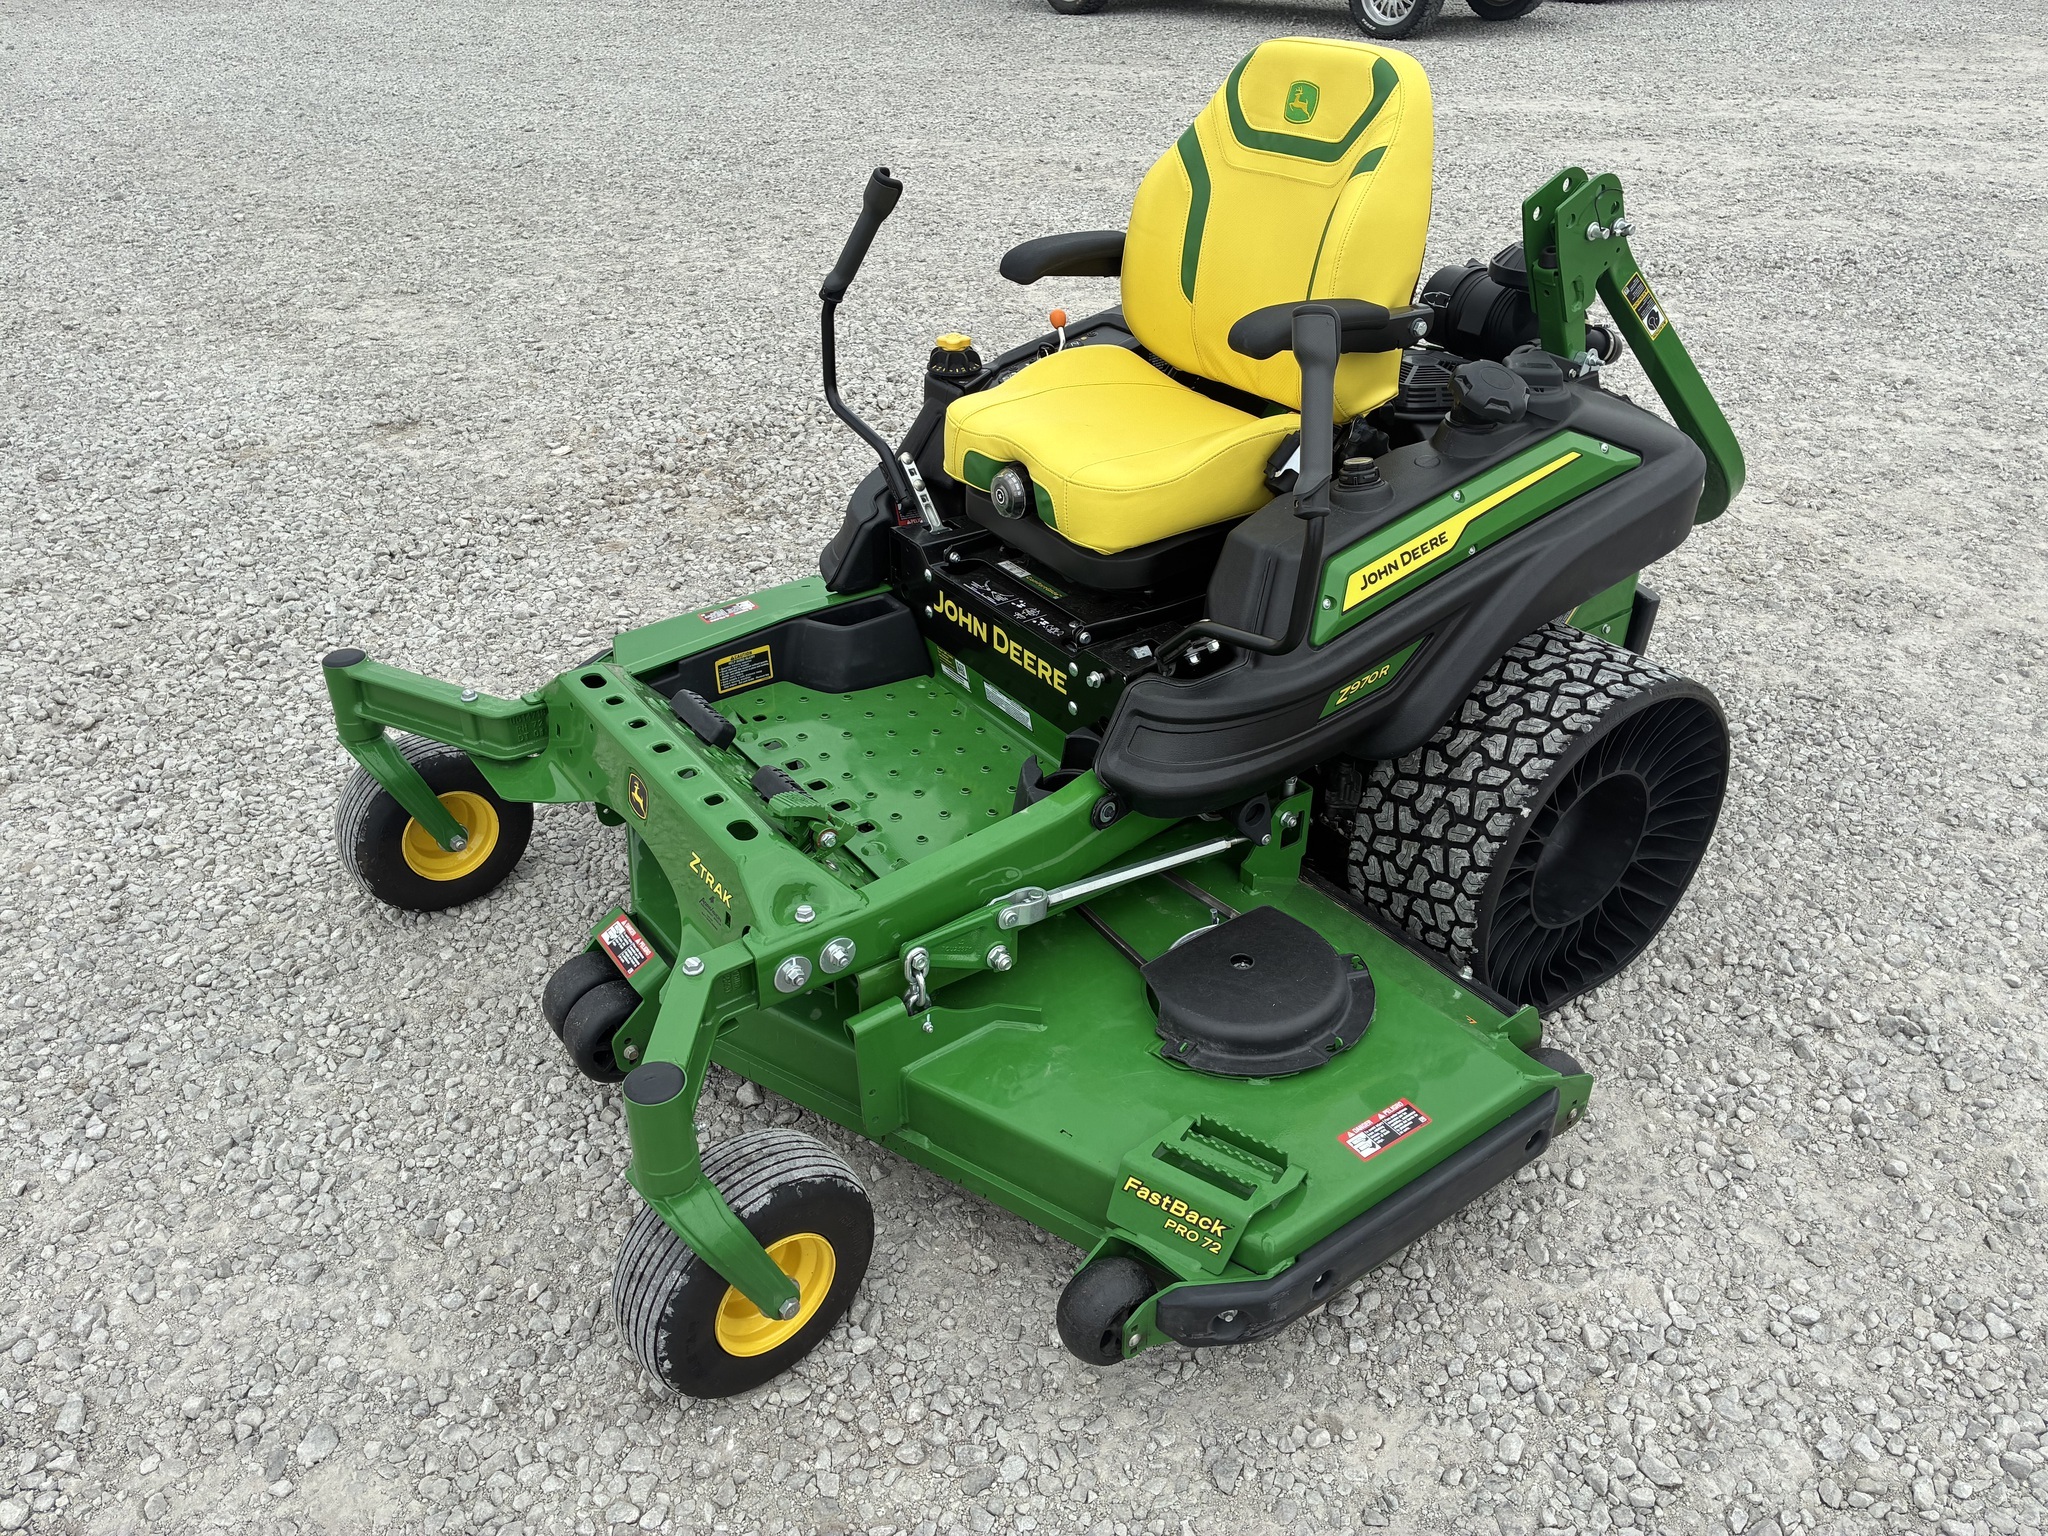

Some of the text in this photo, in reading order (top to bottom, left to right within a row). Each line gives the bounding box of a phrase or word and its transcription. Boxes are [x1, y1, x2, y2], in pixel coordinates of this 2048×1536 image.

[1360, 531, 1449, 591] JOHN DEERE
[933, 590, 988, 644] JOHN
[993, 624, 1068, 696] DEERE
[1335, 664, 1391, 706] Z970R
[689, 851, 733, 910] ZTRAK
[1352, 1101, 1404, 1134] DANGER PELIGRO
[1122, 1175, 1230, 1239] FastBack
[1163, 1217, 1222, 1256] PRO 72
